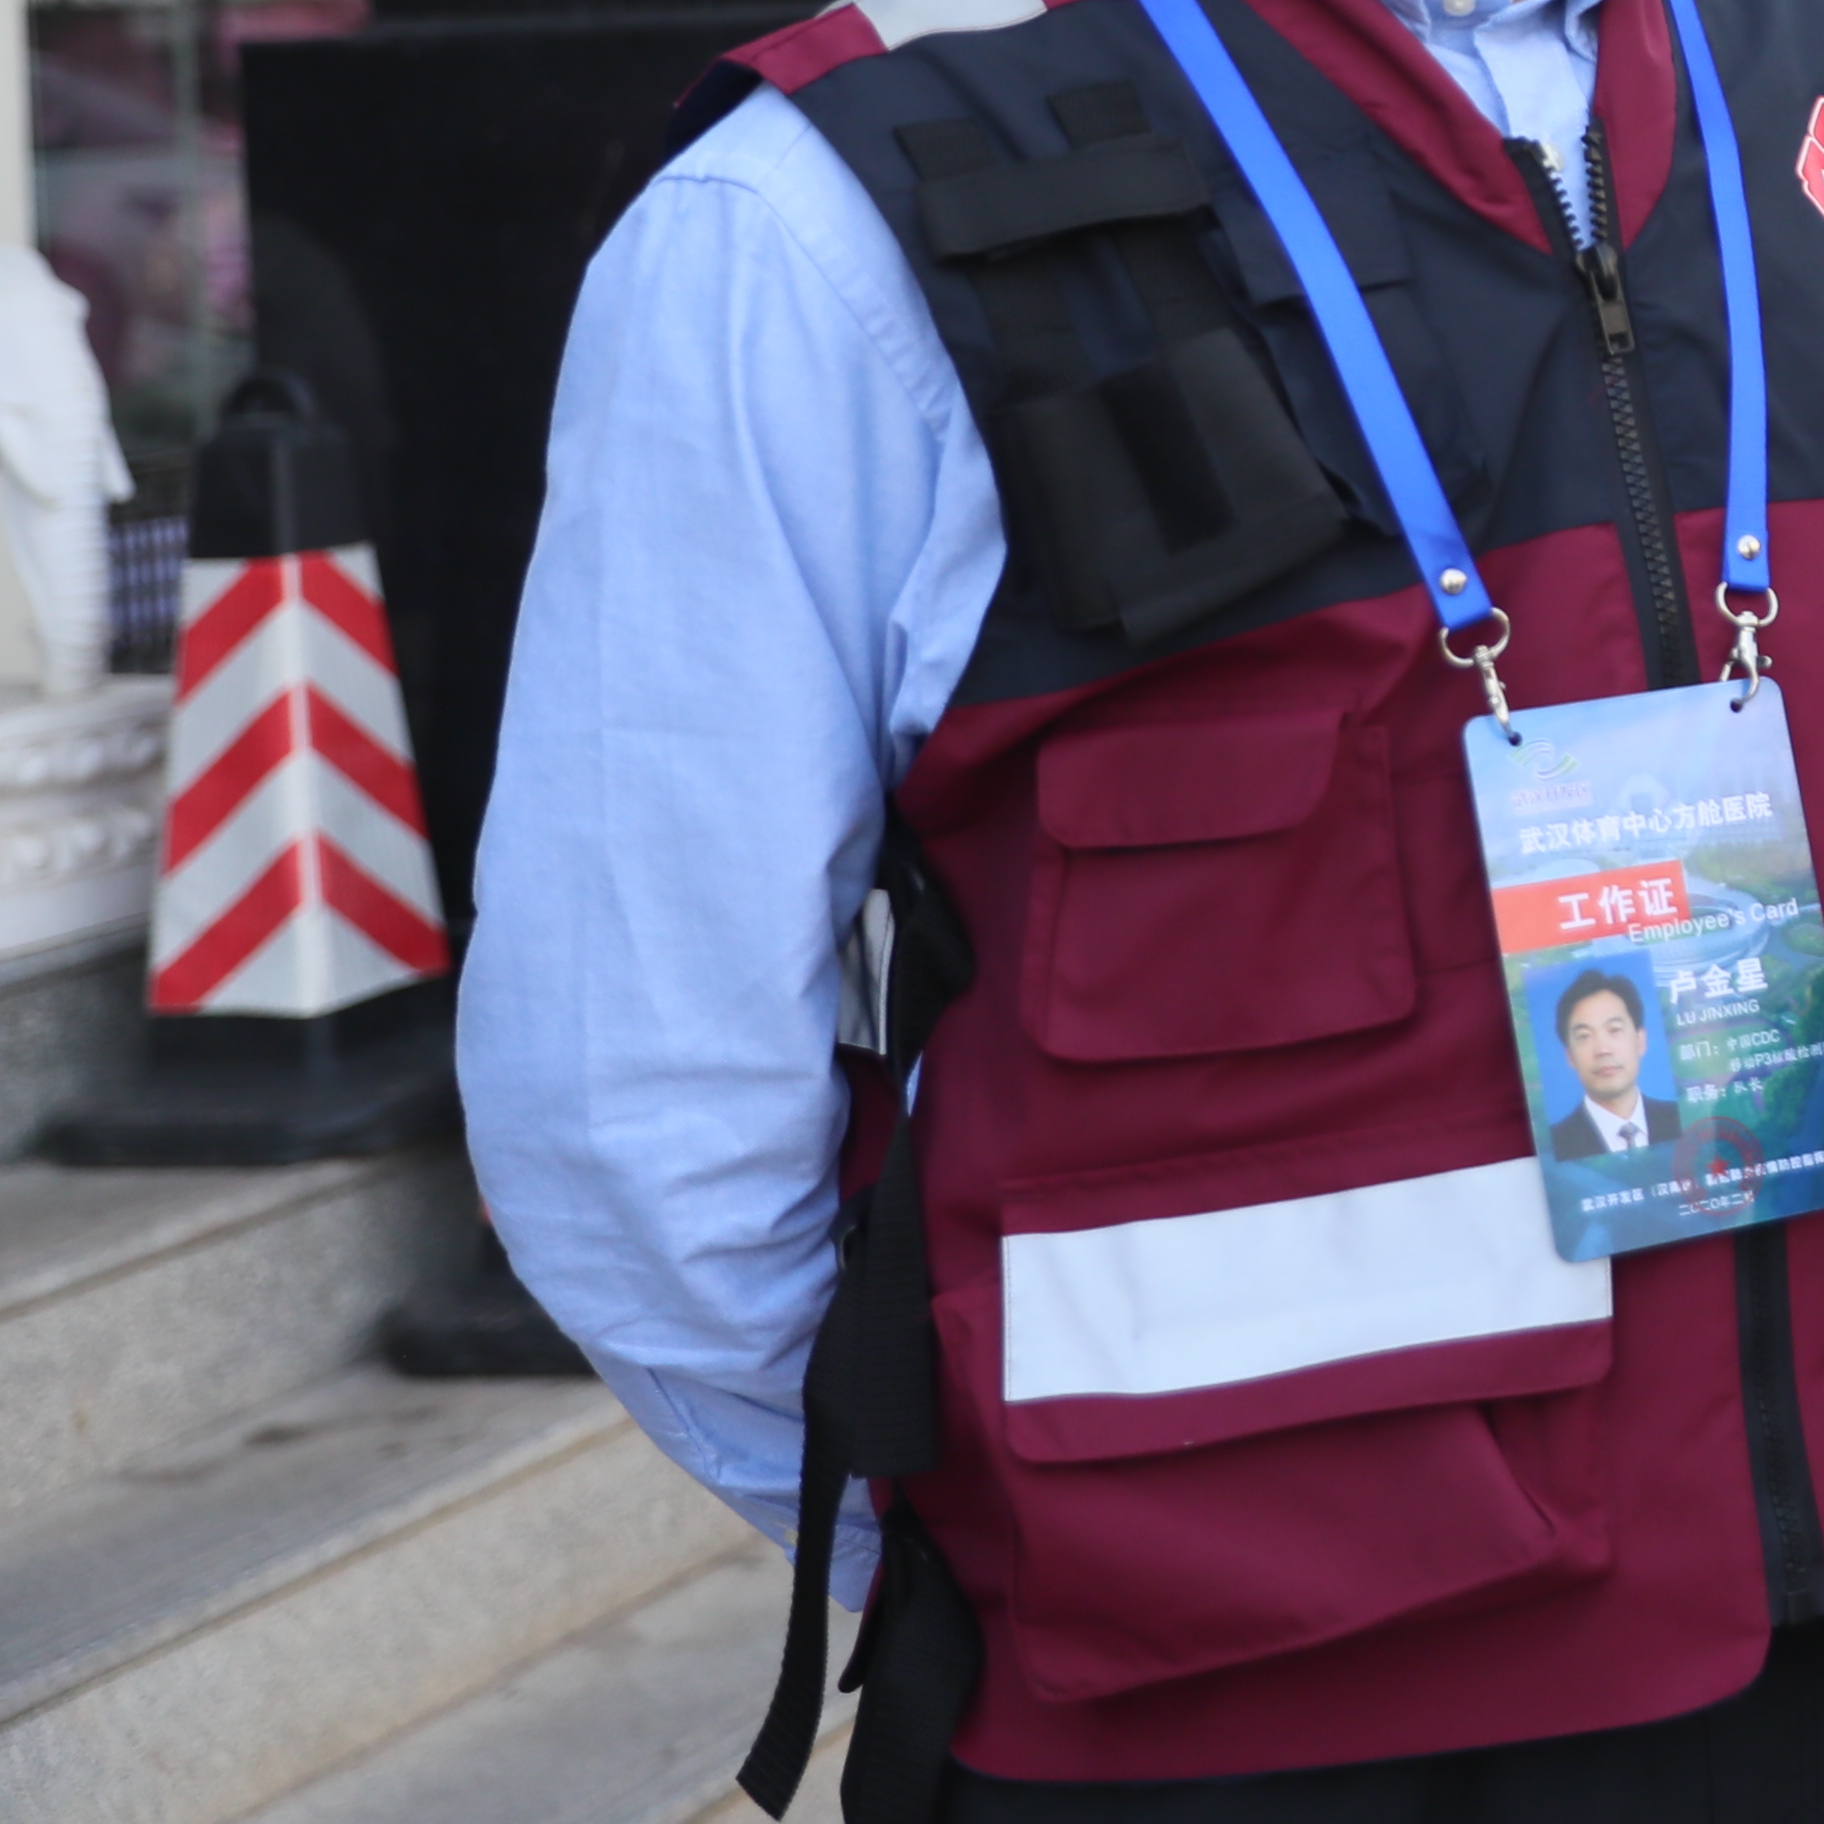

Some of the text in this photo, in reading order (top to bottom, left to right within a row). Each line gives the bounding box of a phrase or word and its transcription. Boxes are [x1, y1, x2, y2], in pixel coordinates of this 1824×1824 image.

[1518, 791, 1774, 856] 武汉体育中心方舱医院
[1558, 878, 1679, 931] 工作证
[1627, 897, 1799, 943] Employee's Card
[1668, 957, 1769, 1005] 卢金星
[1676, 999, 1761, 1026] LU JINXING
